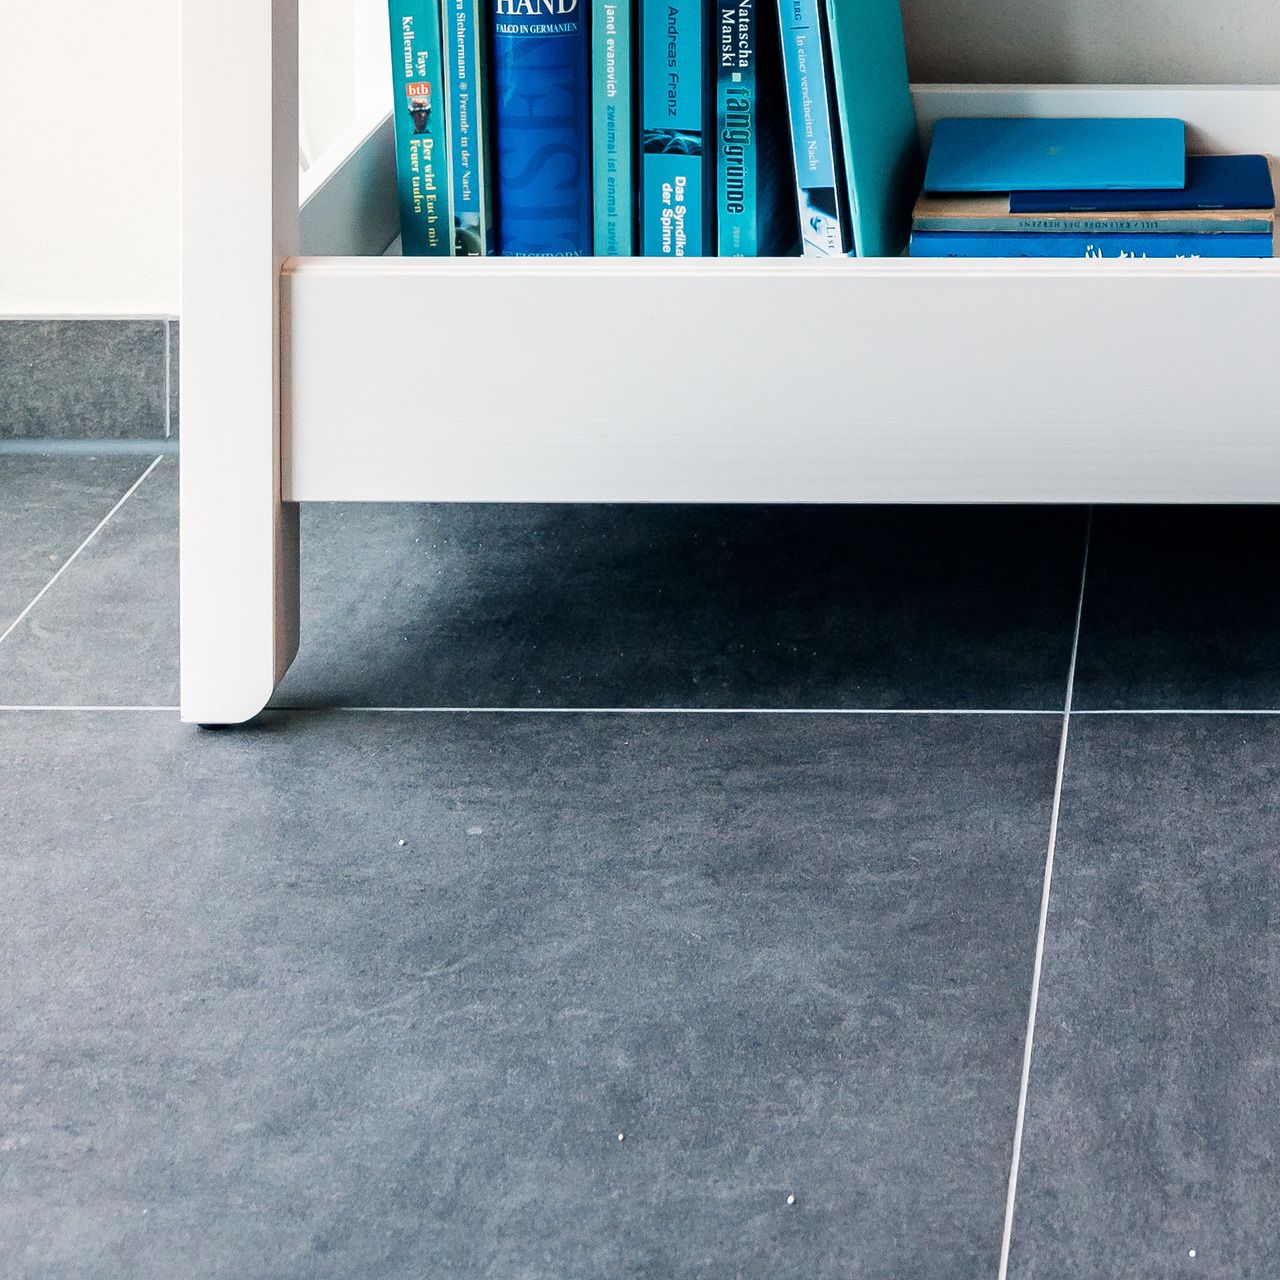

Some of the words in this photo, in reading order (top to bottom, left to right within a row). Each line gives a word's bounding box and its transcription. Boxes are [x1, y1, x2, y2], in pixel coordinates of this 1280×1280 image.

[496, 24, 519, 34] FALCO
[520, 24, 529, 34] IN
[530, 22, 578, 34] GERMANIEN
[604, 4, 617, 34] janet
[402, 16, 415, 78] Kellerman
[456, 12, 466, 79] Sichtermann
[667, 6, 679, 68] Andreas
[722, 8, 735, 67] Manski
[796, 35, 806, 46] In
[416, 51, 429, 77] Faye
[606, 38, 617, 97] evanovich
[797, 48, 808, 73] einer
[408, 83, 429, 96] btb
[667, 72, 679, 117] Franz
[458, 93, 470, 134] Fremde
[801, 75, 815, 138] verschneiten
[460, 137, 470, 147] in
[606, 105, 617, 154] zweimal
[409, 139, 421, 173] Feuer
[422, 138, 434, 161] Der
[460, 149, 471, 169] der
[807, 140, 820, 171] Nacht
[423, 164, 436, 191] wird
[607, 159, 617, 173] ist
[411, 176, 424, 214] taufen
[461, 171, 472, 201] Nacht
[607, 177, 618, 217] einmal
[661, 183, 673, 206] der
[675, 176, 687, 202] Das
[660, 208, 673, 254] Spinne
[826, 226, 837, 249] List
[1084, 221, 1131, 229] KALENDER
